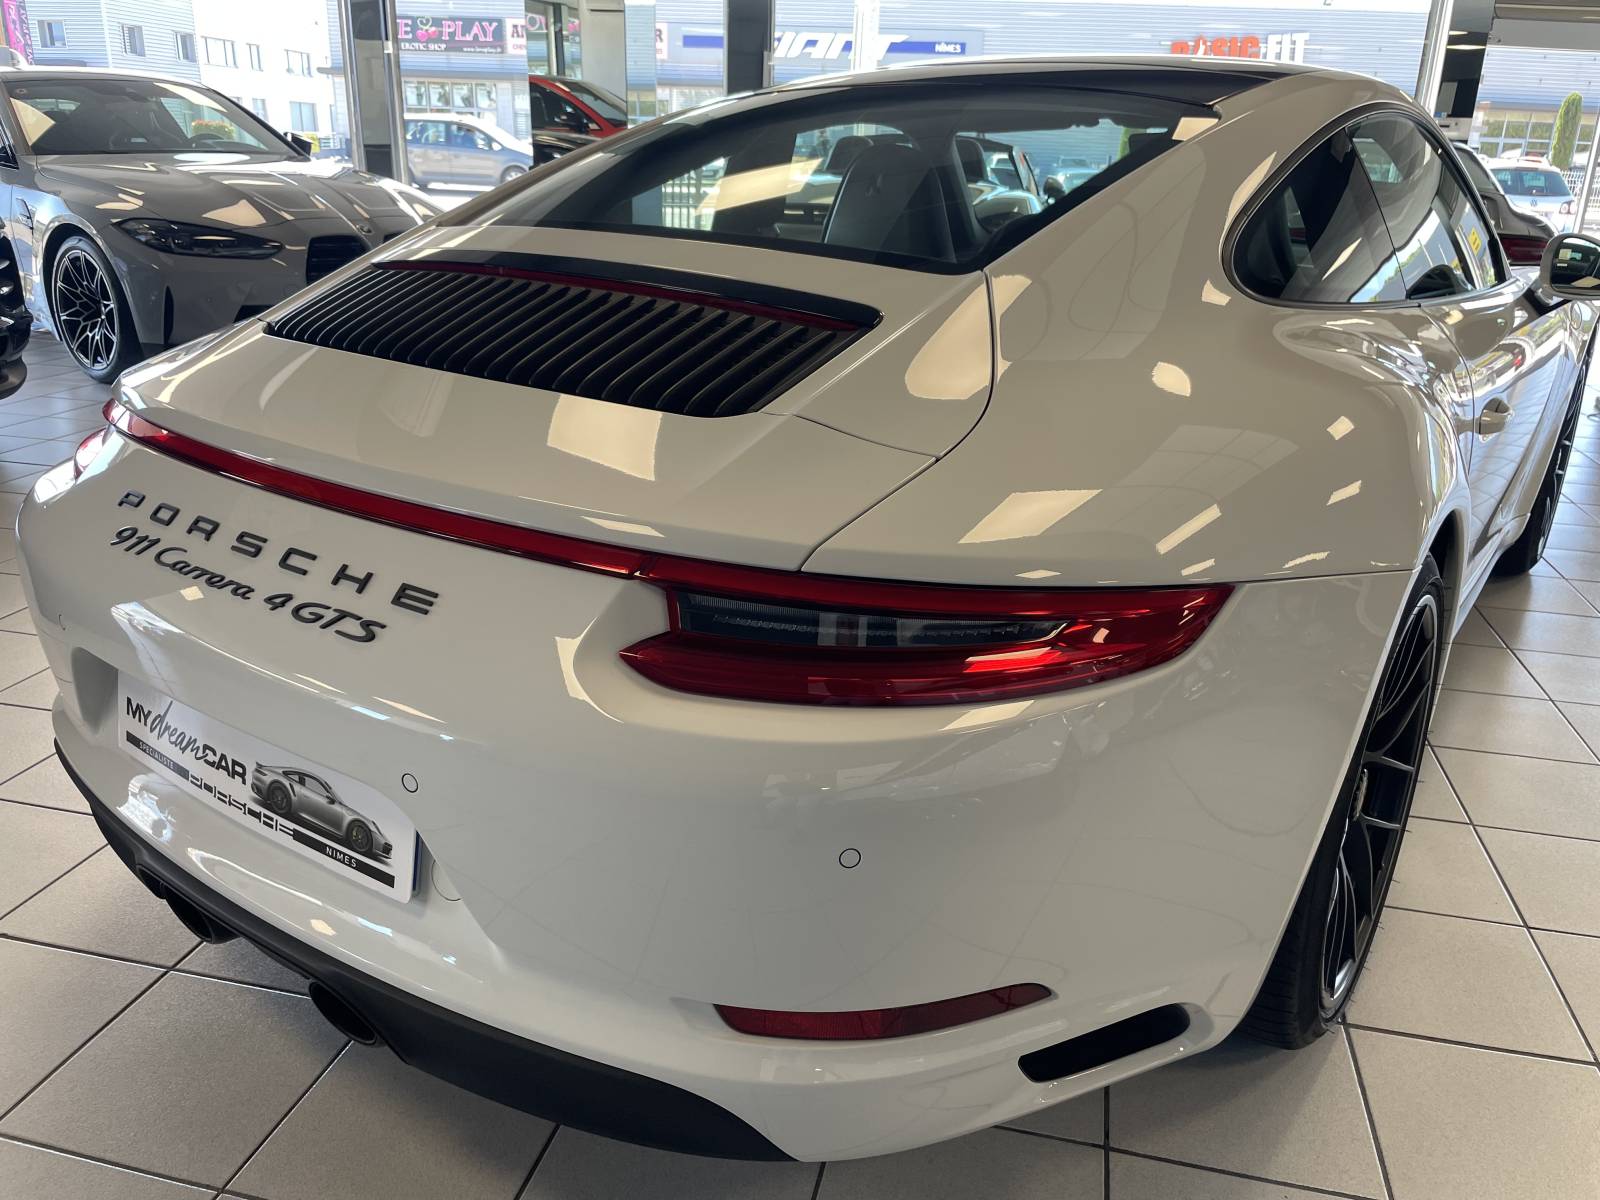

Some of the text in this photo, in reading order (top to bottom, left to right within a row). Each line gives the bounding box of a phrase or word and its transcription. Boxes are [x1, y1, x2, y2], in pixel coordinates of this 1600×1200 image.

[428, 43, 447, 51] SHOP
[441, 20, 498, 42] PLAY
[110, 525, 162, 556] 911
[154, 546, 255, 600] Carrera
[117, 489, 439, 616] PORSCHE
[190, 773, 294, 836] PORSCHE
[325, 847, 358, 869] NIMES
